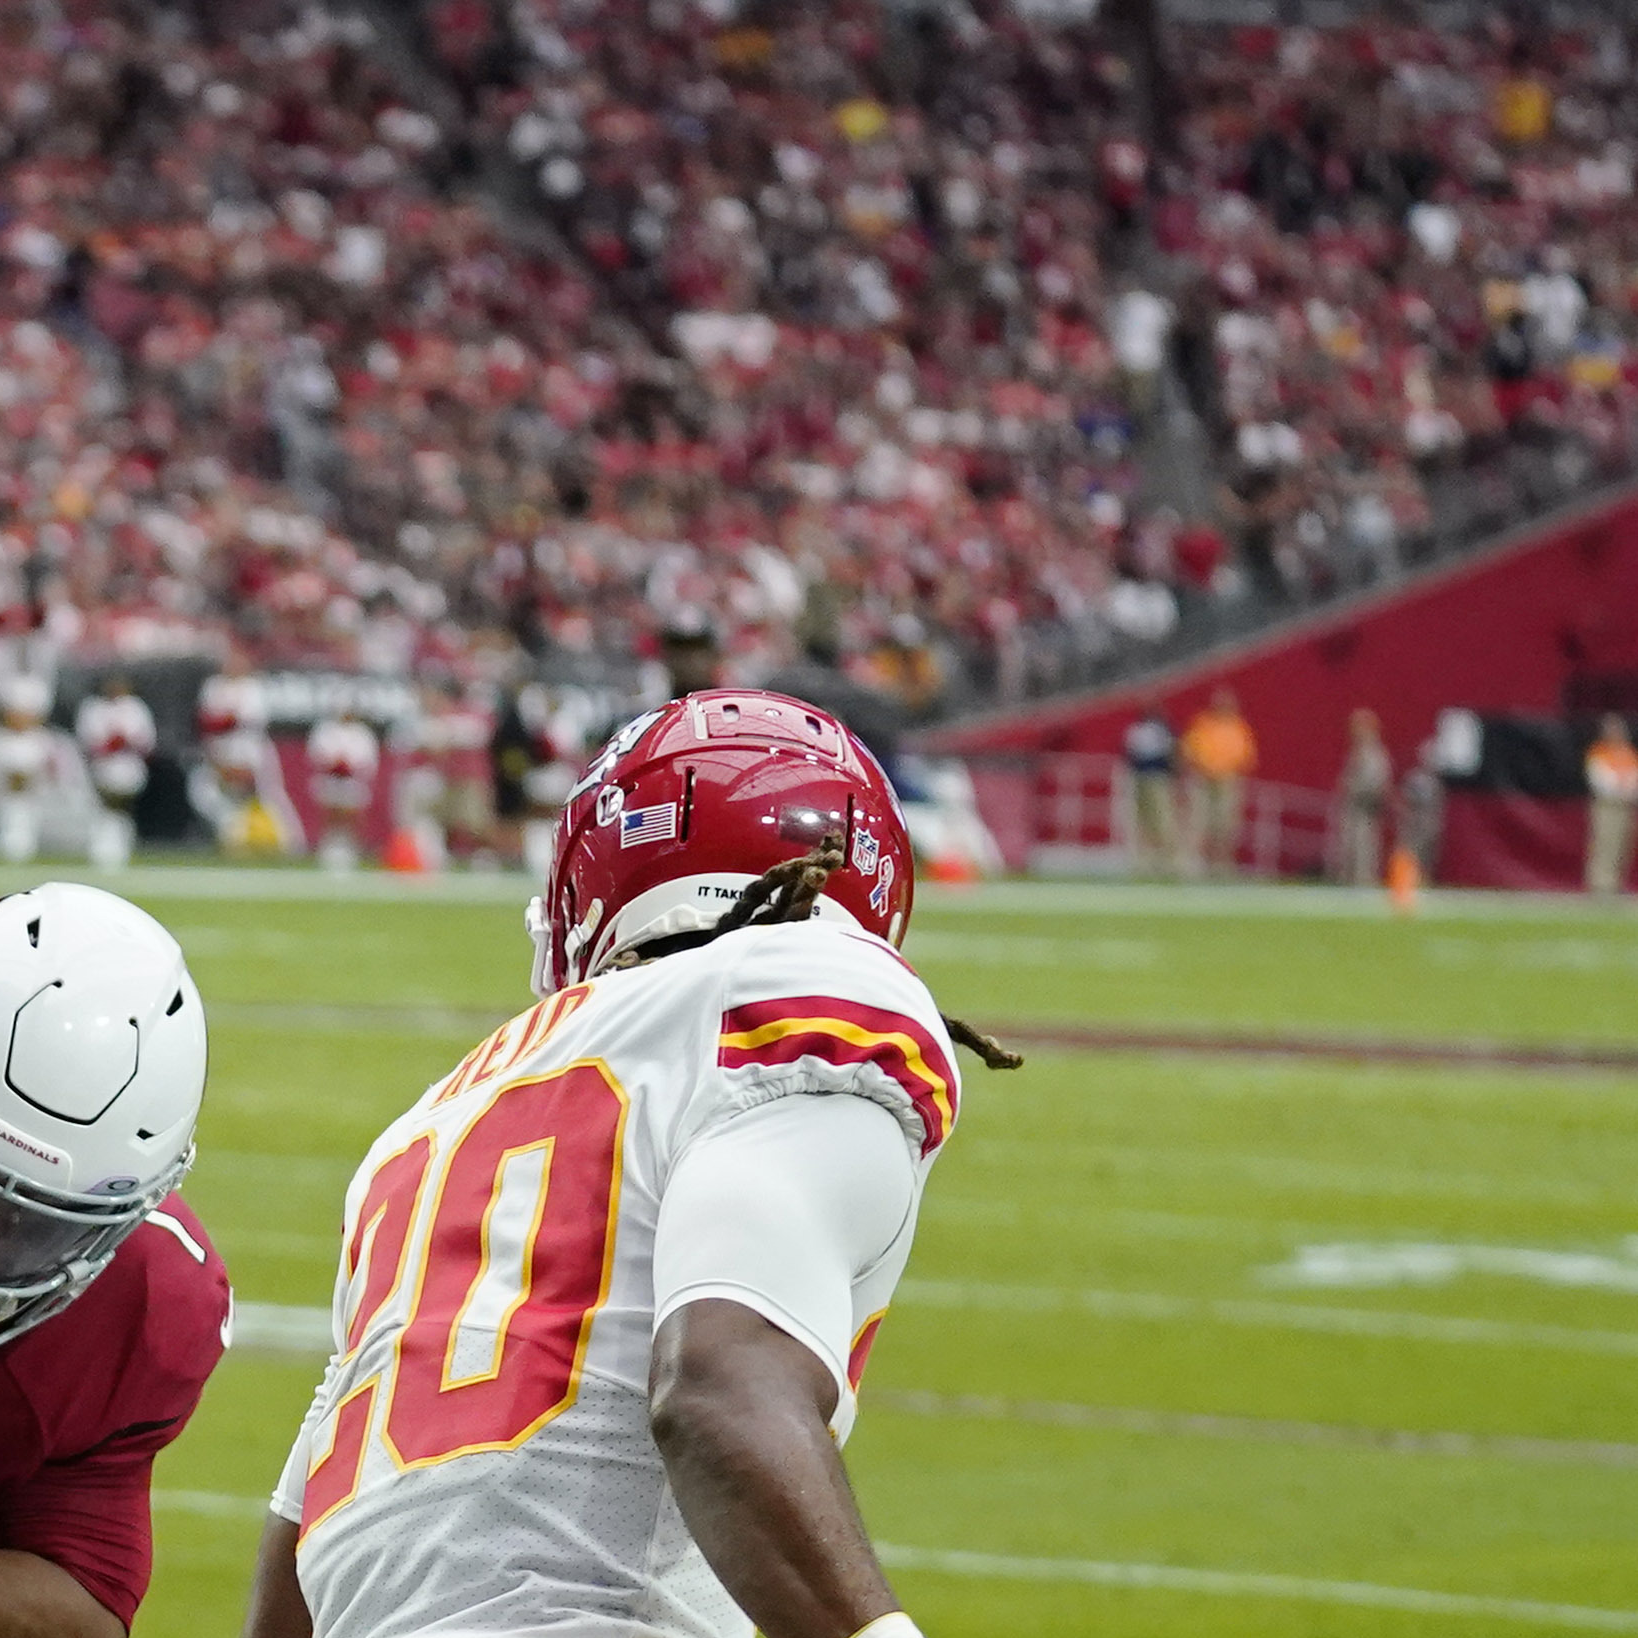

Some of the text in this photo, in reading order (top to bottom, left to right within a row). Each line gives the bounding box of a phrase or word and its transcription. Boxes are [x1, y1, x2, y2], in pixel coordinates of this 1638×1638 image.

[698, 886, 710, 896] IT
[428, 983, 595, 1110] REID
[296, 1057, 630, 1553] 20
